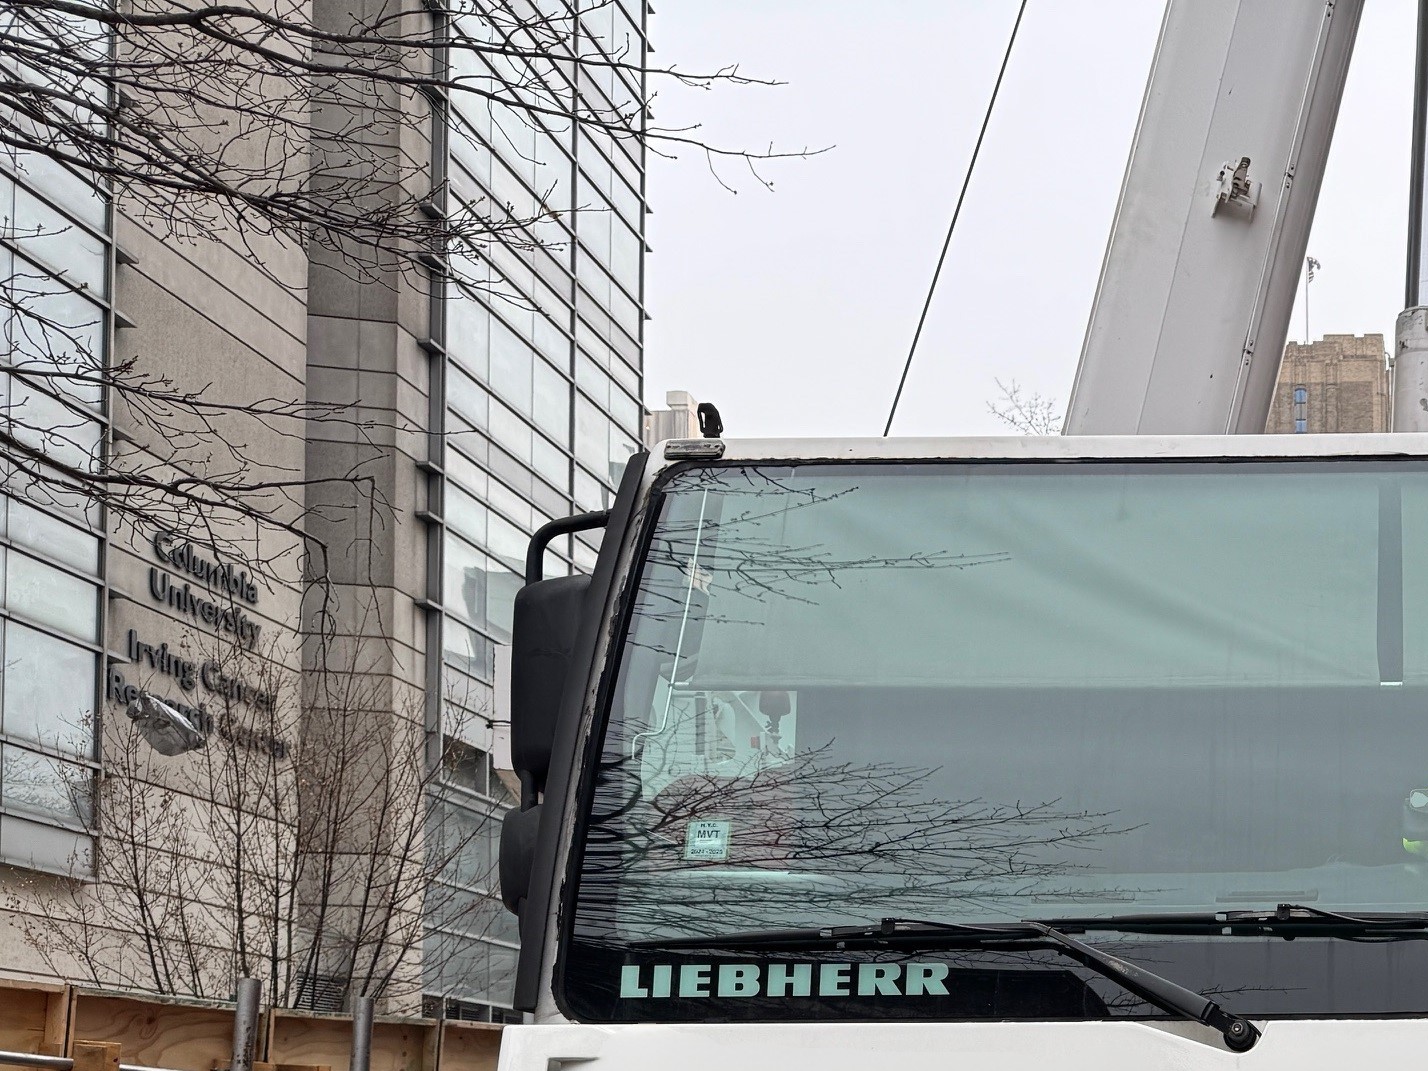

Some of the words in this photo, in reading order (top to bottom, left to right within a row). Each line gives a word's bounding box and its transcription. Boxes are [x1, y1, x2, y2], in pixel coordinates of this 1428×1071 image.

[154, 530, 259, 604] Columbia
[149, 566, 263, 649] University
[128, 628, 197, 691] Irving
[697, 830, 721, 838] MVT
[620, 962, 950, 998] LIEBHERR
